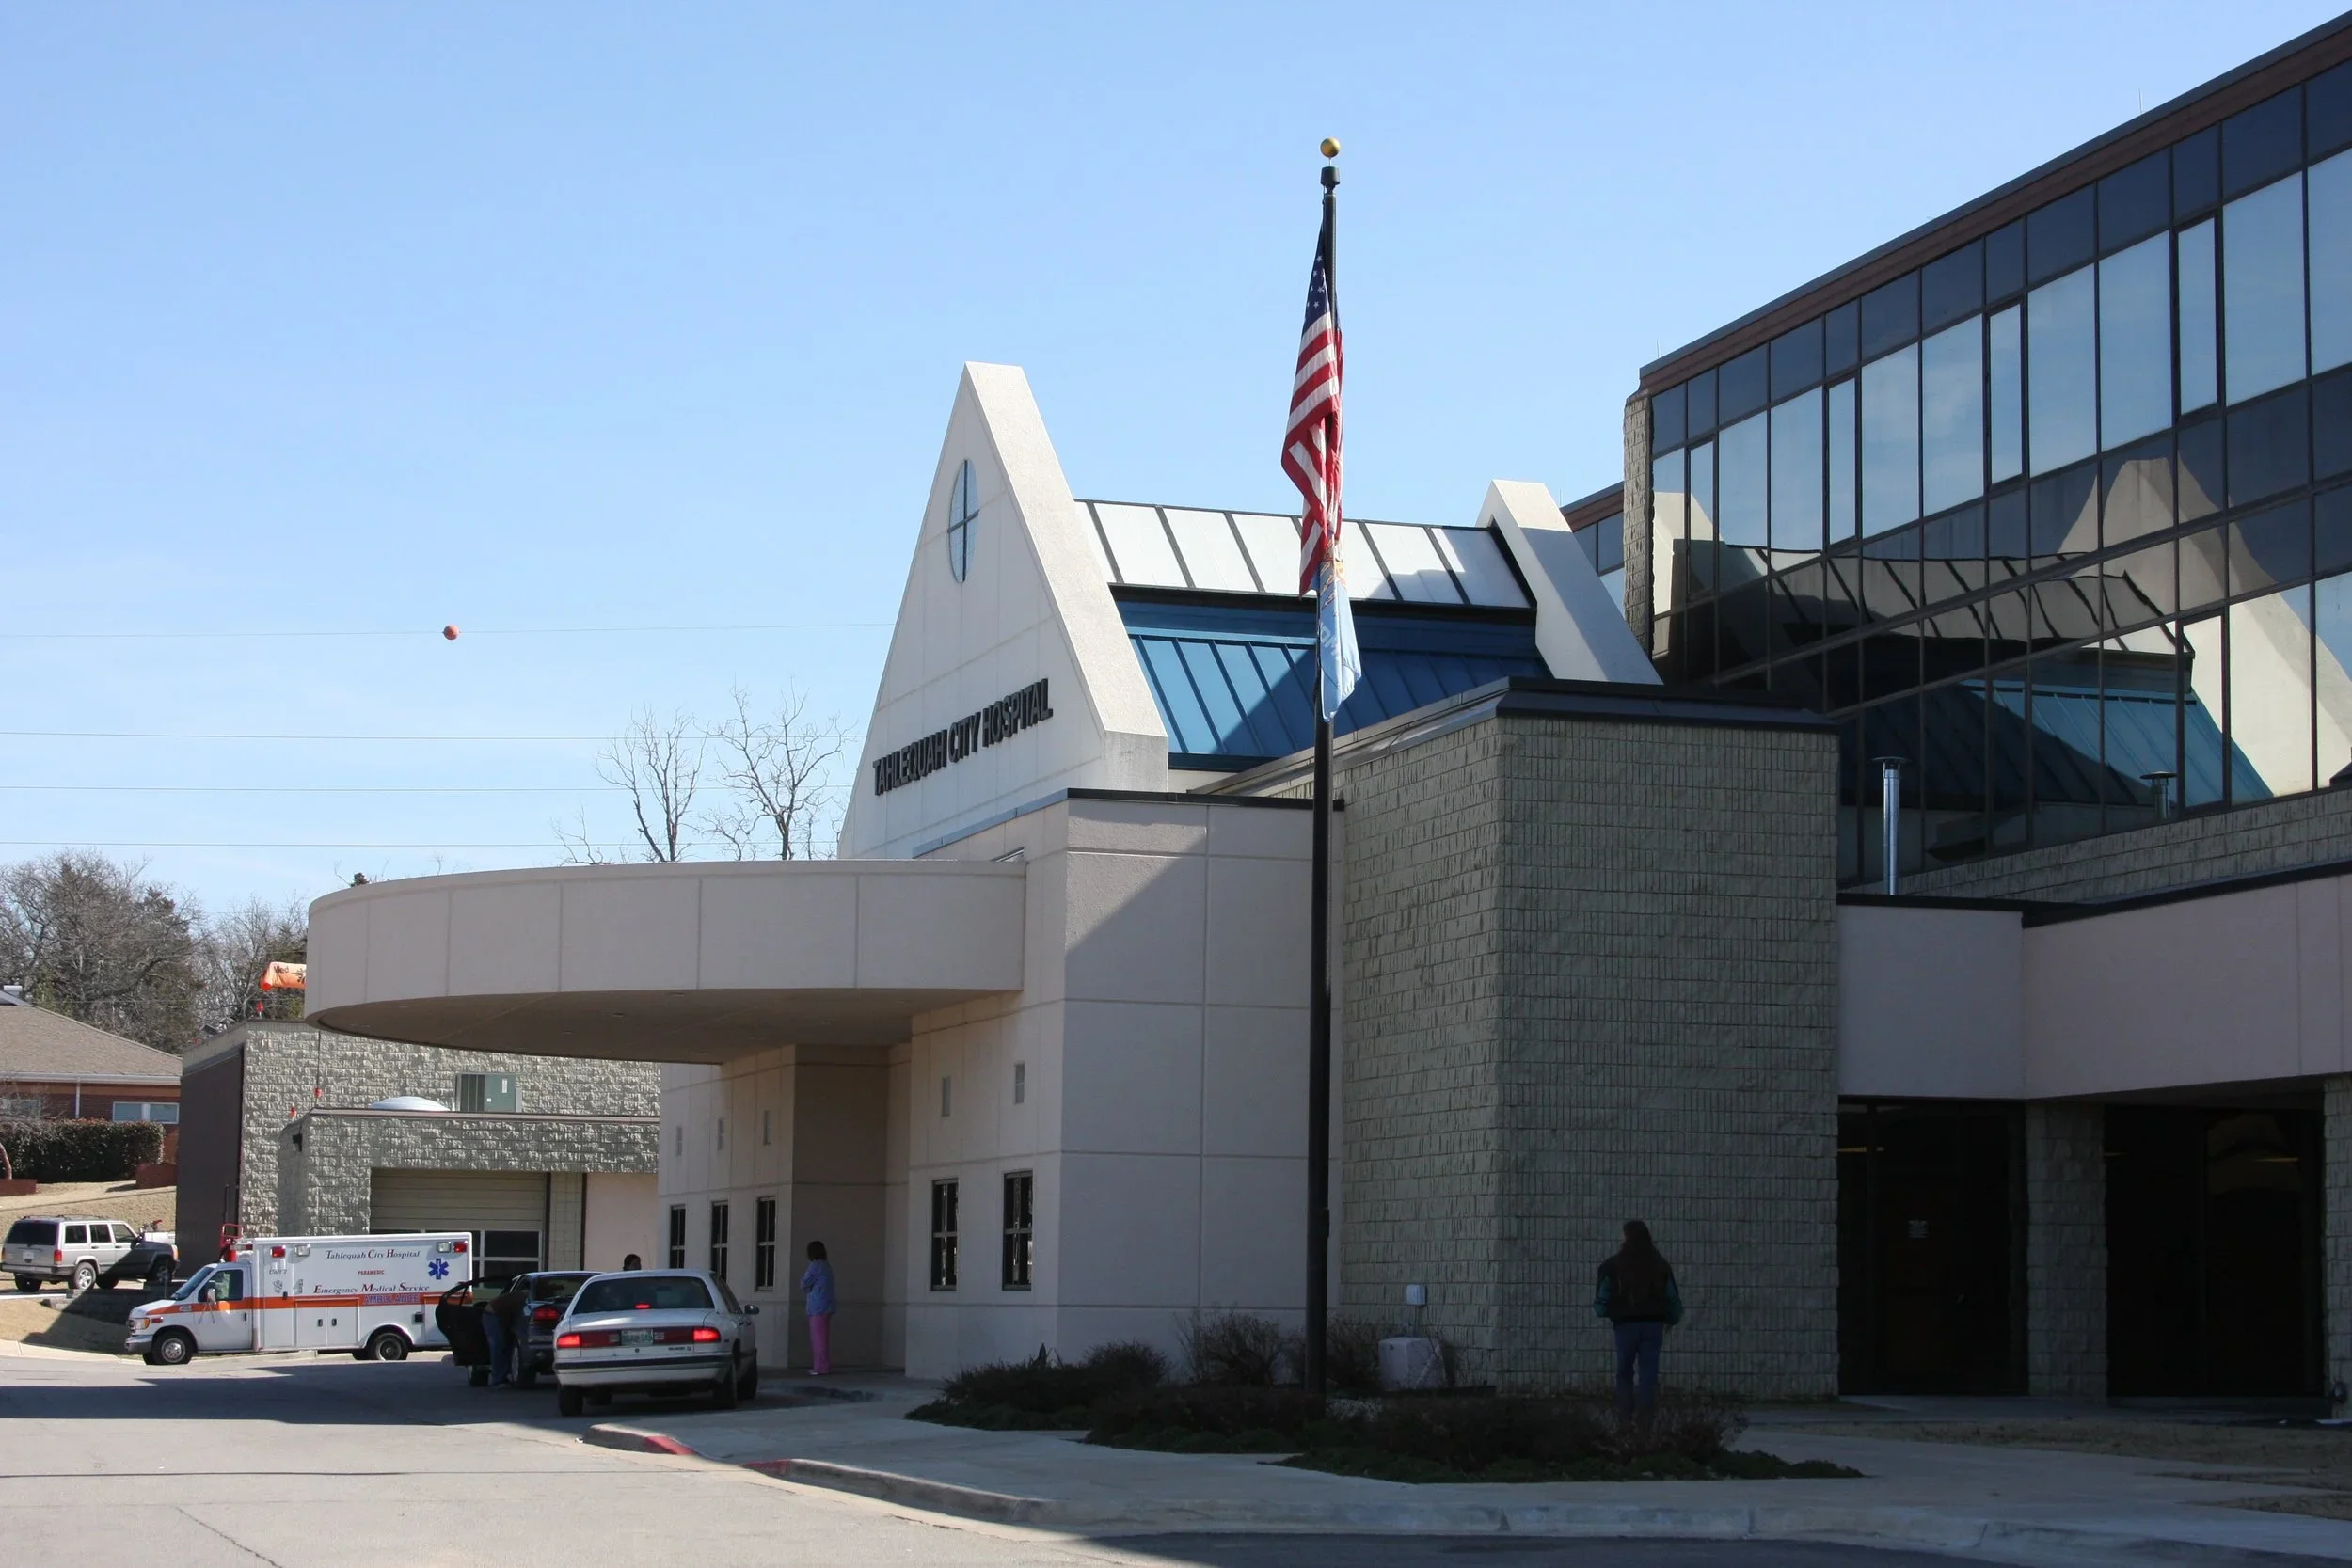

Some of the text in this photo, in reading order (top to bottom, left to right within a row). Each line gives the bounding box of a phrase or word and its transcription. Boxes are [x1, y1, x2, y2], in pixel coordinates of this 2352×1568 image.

[873, 677, 1054, 796] TAHLEQUAH CITY HOSPITAL
[326, 1248, 421, 1260] Tahlequah City Hospital
[313, 1282, 430, 1294] Emergency Medical Service
[363, 1294, 420, 1305] AMBULANCE
